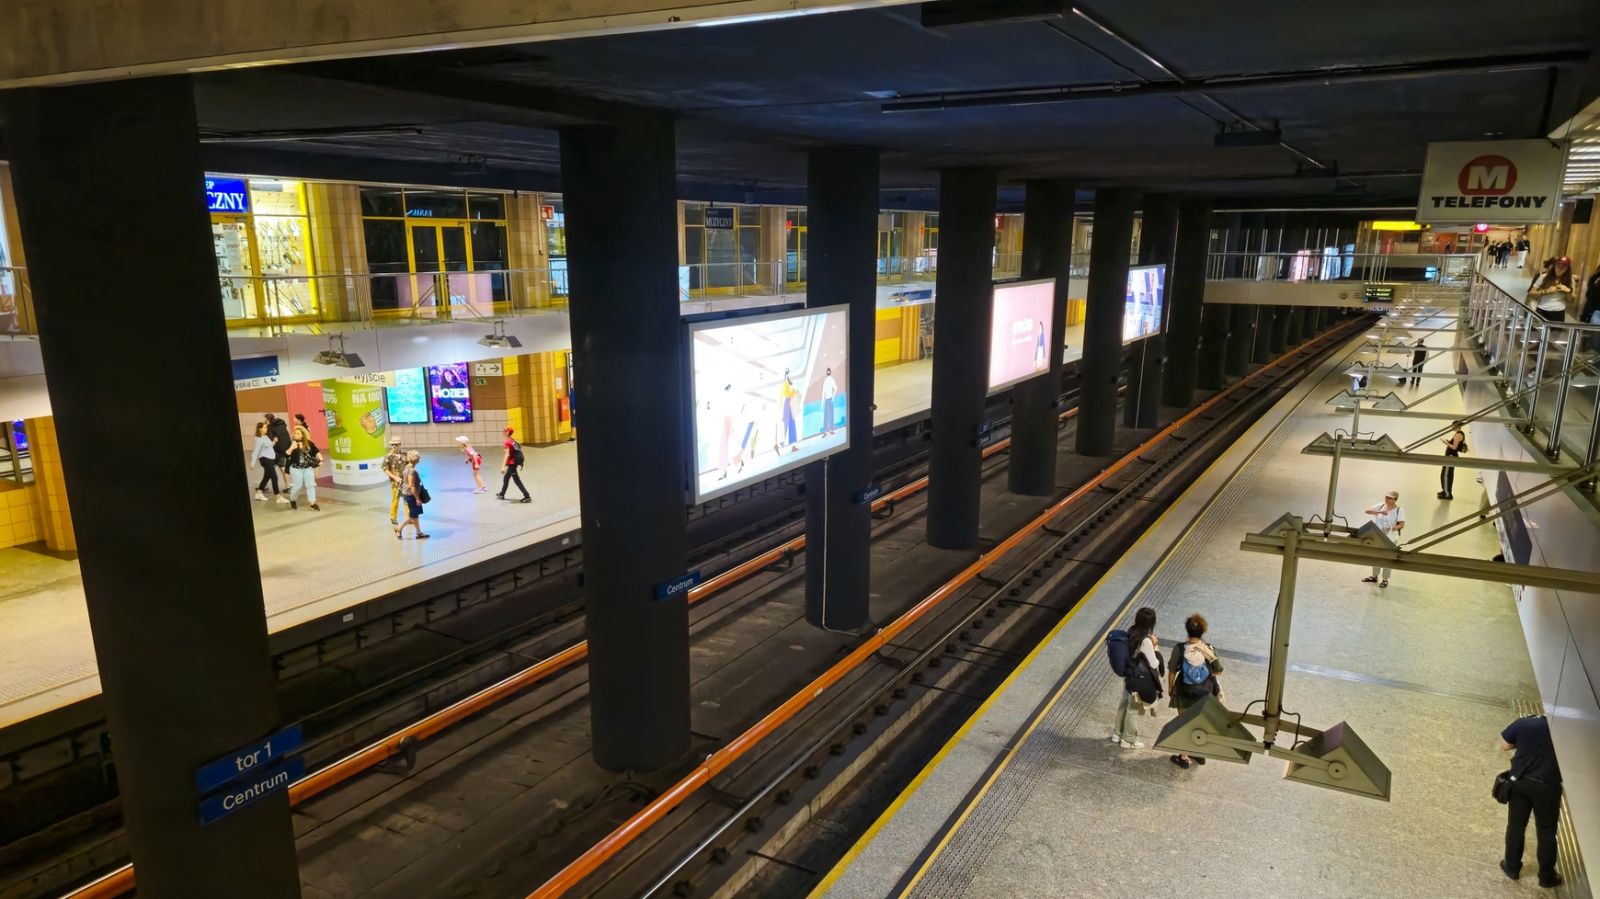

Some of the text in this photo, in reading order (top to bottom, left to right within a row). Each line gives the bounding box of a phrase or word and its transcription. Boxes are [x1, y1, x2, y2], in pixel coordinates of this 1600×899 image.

[1467, 165, 1509, 189] M
[1431, 196, 1547, 208] TELEFONY
[667, 578, 693, 595] Centrum
[235, 741, 272, 771] tor 1
[223, 771, 288, 810] Centrum
